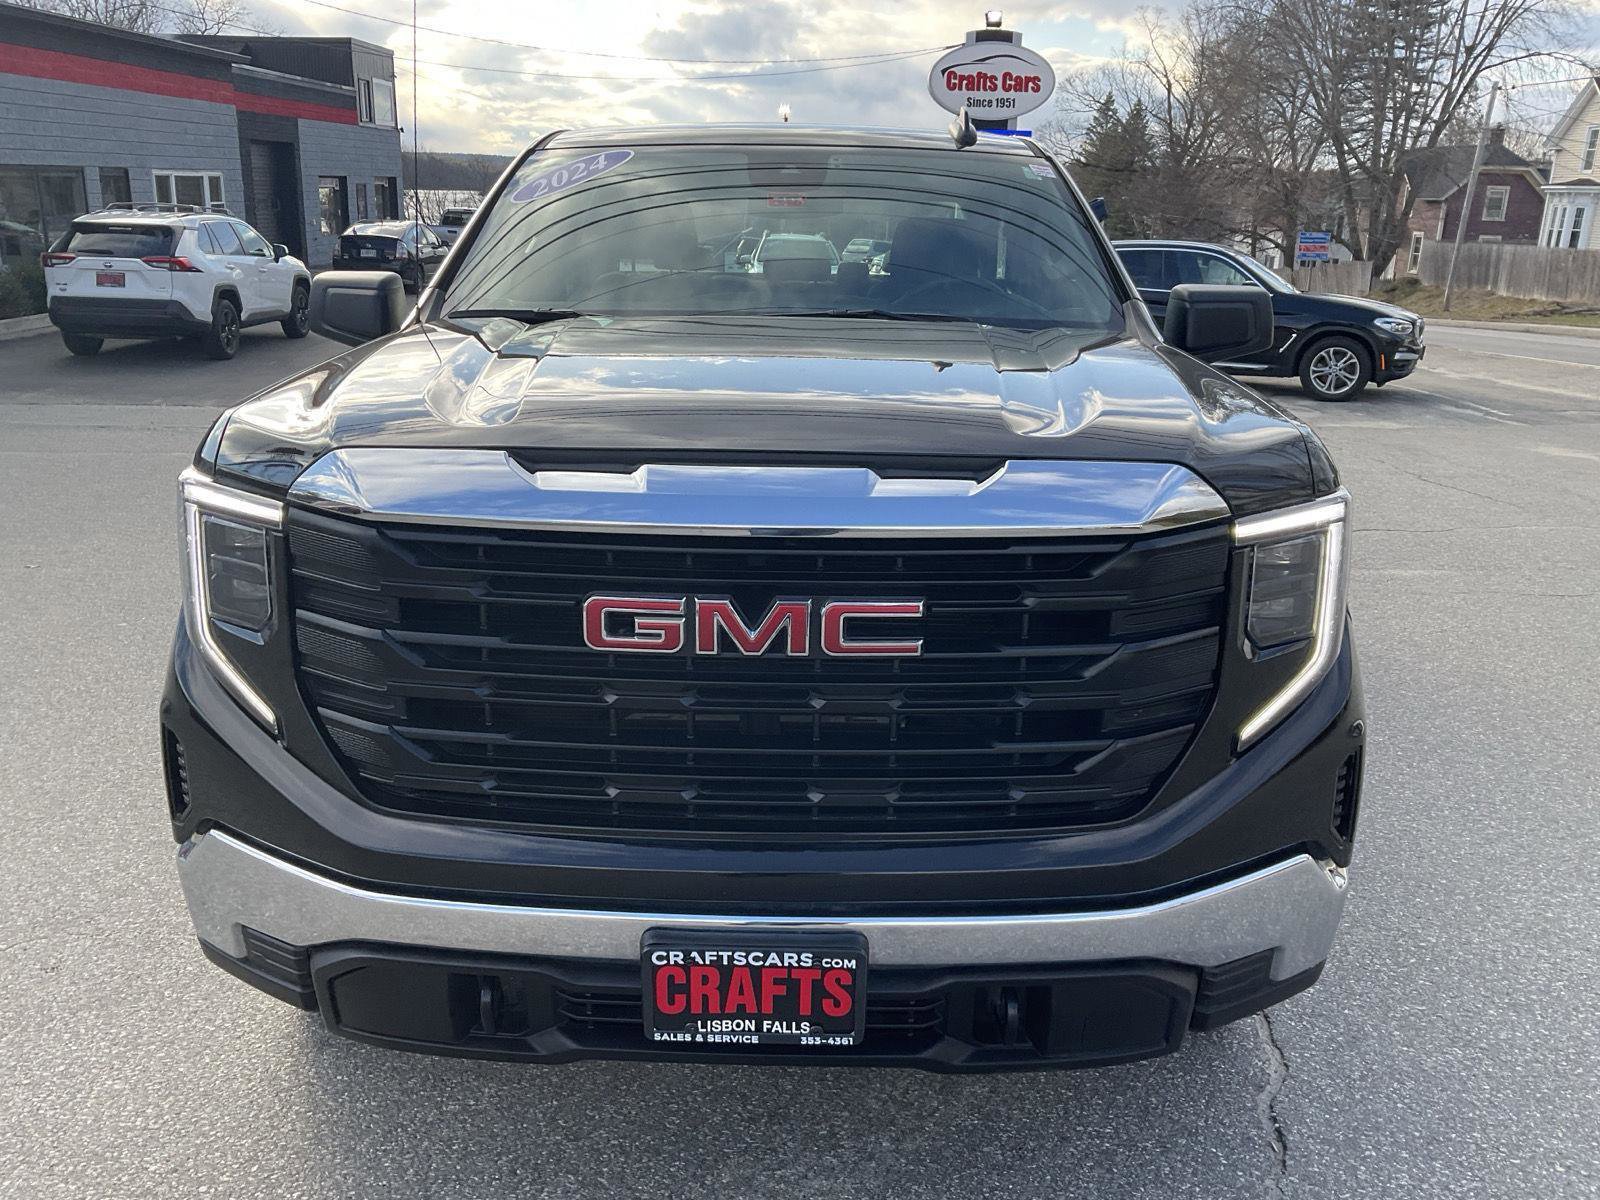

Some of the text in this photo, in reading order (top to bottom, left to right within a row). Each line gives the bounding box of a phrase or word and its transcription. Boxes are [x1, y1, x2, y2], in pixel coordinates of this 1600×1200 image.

[945, 70, 1041, 93] Crafts Cars
[966, 97, 1016, 108] Since 1951
[532, 154, 608, 198] 2024
[583, 595, 924, 656] GMC
[655, 966, 853, 1017] CRAFTS
[697, 1019, 811, 1034] LISBON FALLS
[653, 1032, 759, 1044] SALES & SERVICE
[800, 1036, 854, 1045] 353-4361
